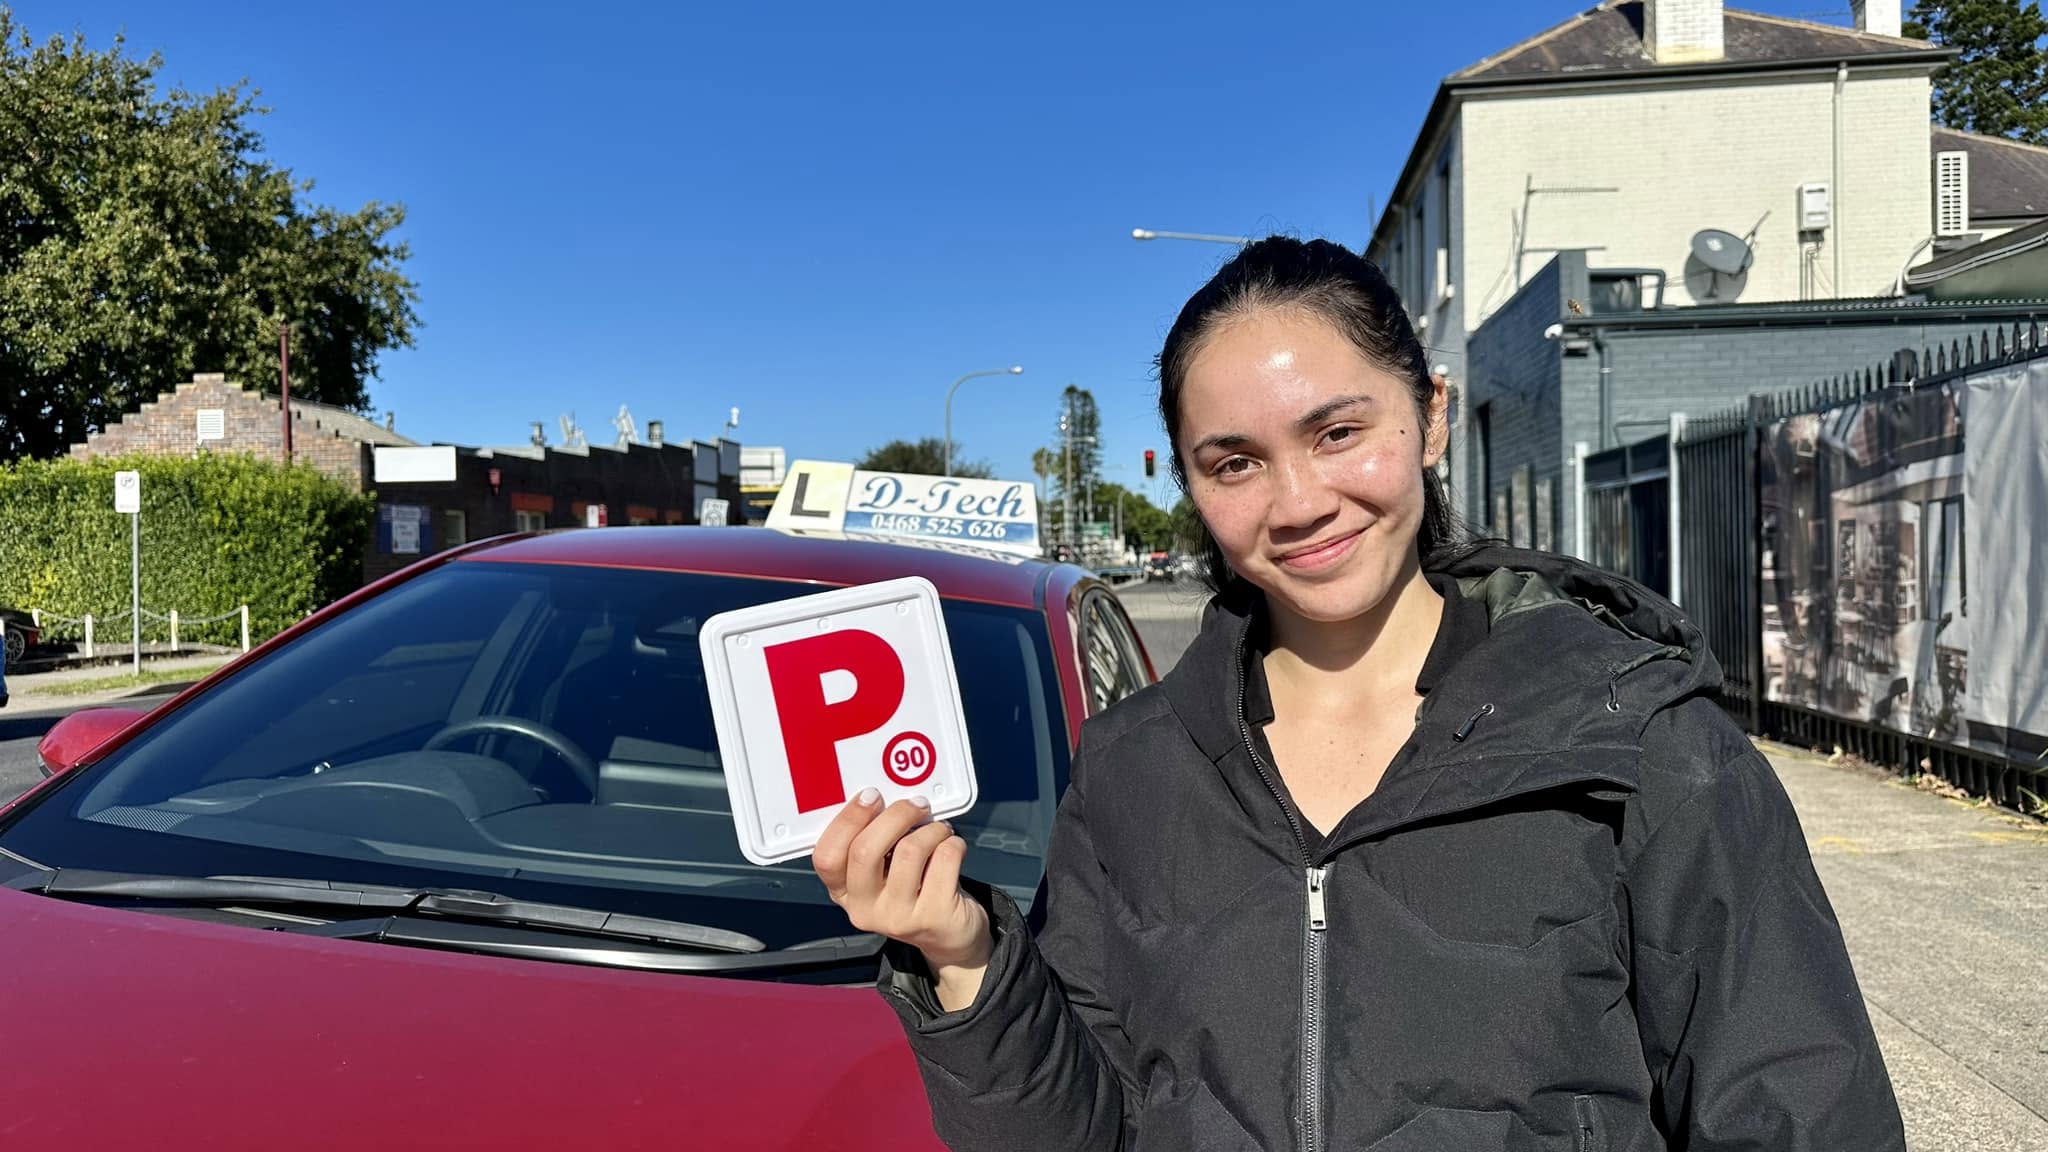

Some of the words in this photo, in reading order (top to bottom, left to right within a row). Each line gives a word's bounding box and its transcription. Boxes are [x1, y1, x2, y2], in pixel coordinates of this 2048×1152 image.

[790, 472, 831, 519] L
[858, 475, 1025, 518] D-Tech
[871, 513, 920, 532] 0468
[926, 517, 964, 536] 525
[968, 521, 1007, 539] 626
[763, 629, 905, 814] P
[894, 745, 925, 771] 90
